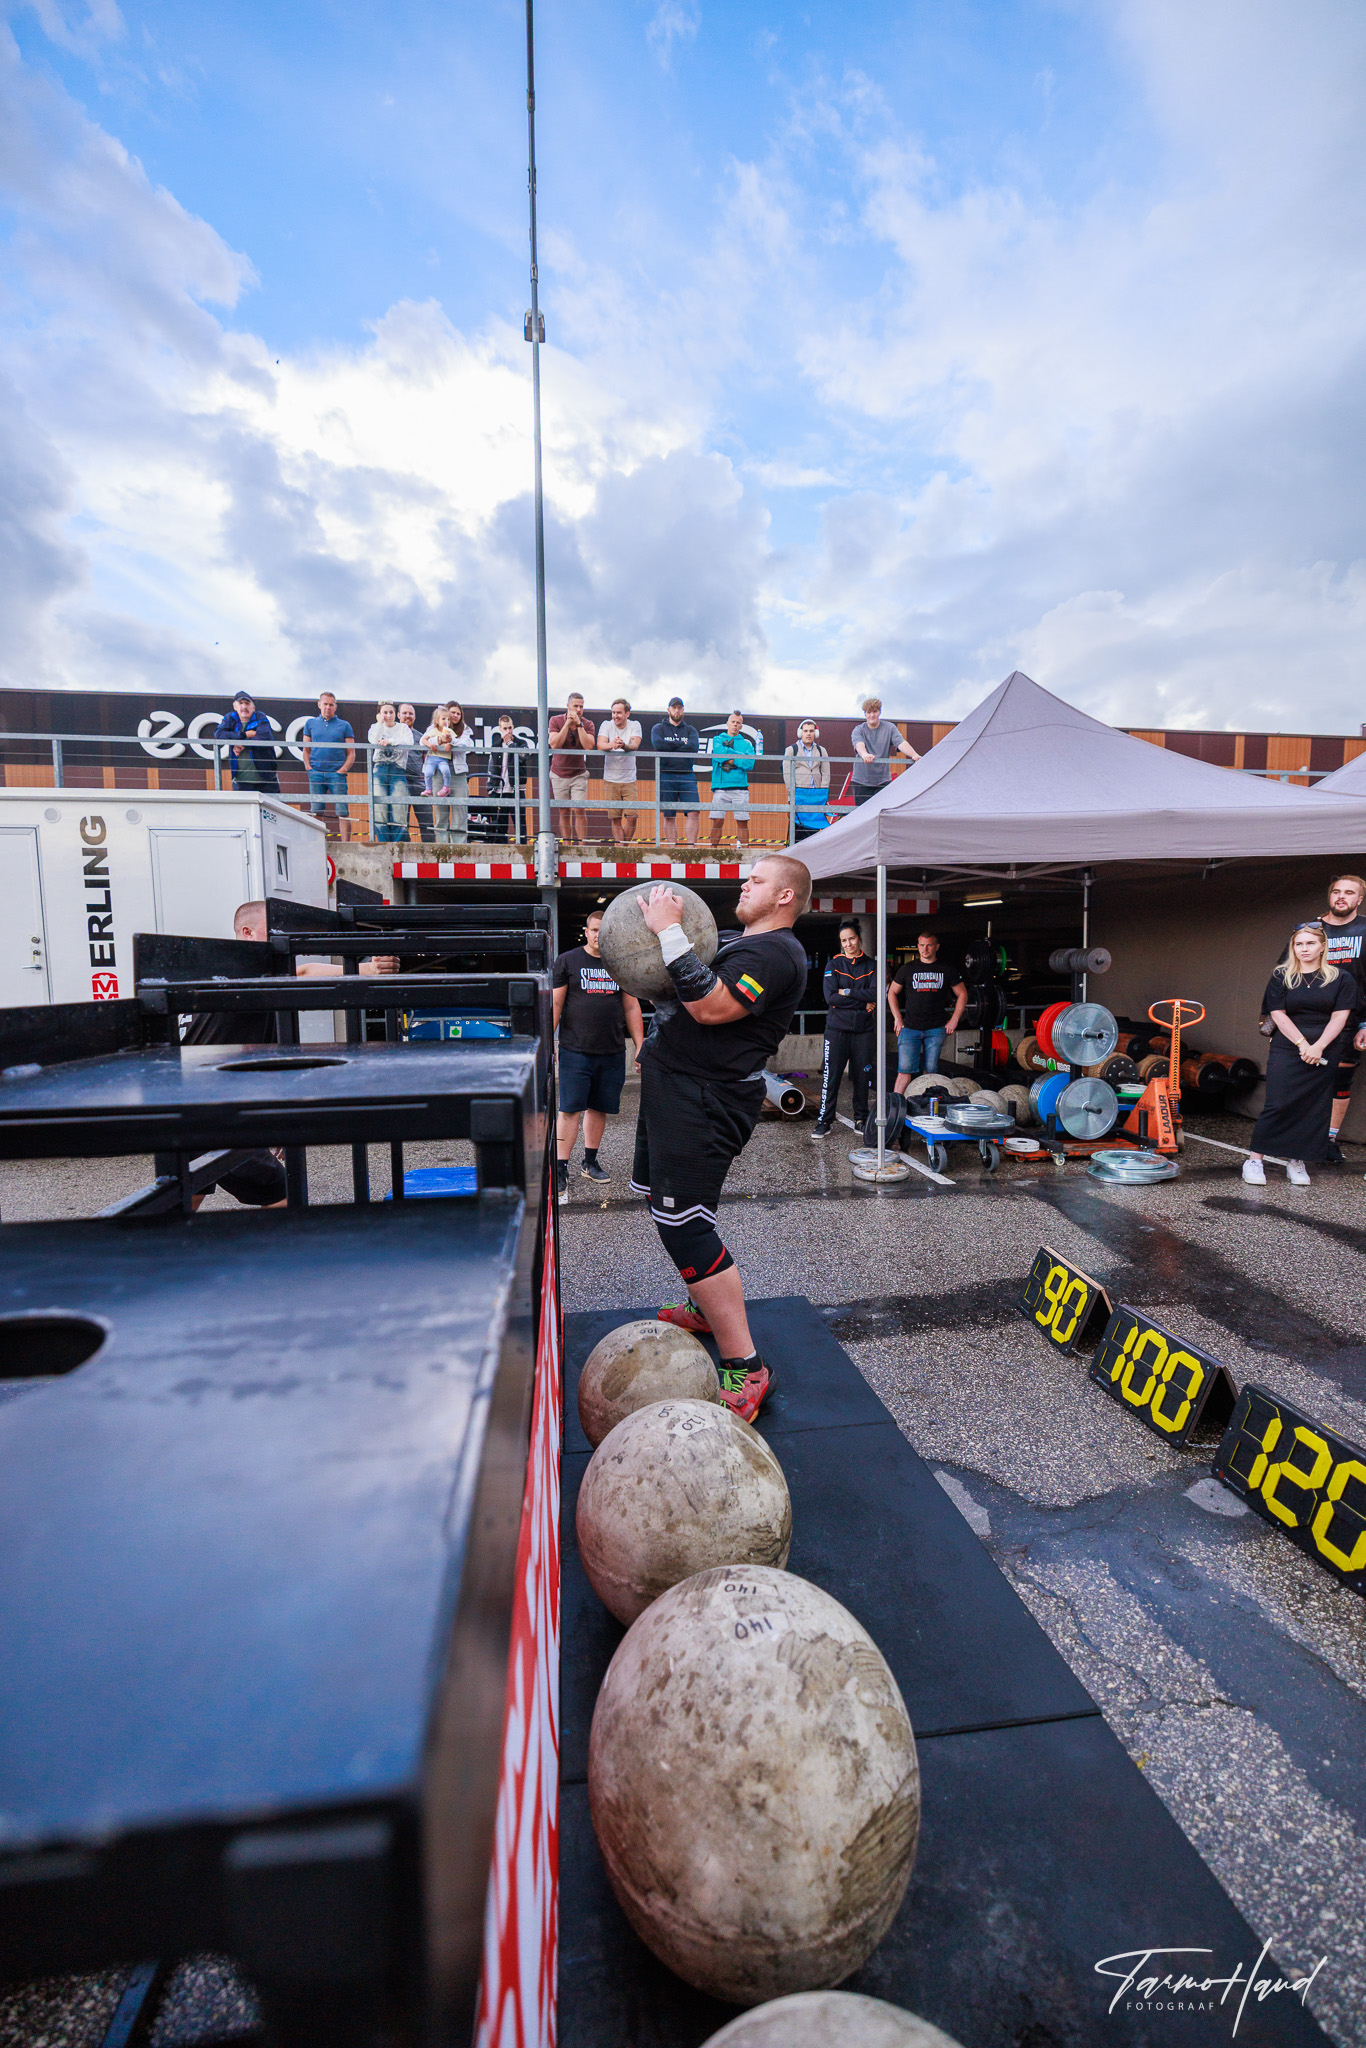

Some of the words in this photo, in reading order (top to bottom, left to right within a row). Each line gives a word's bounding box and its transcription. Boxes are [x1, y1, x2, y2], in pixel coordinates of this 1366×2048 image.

[79, 815, 117, 968] ERLING
[818, 1088, 828, 1122] ESTON
[1158, 1094, 1172, 1134] LAADUR
[1035, 1264, 1089, 1345] 90
[1110, 1325, 1205, 1434] 100
[1248, 1416, 1366, 1573] 120
